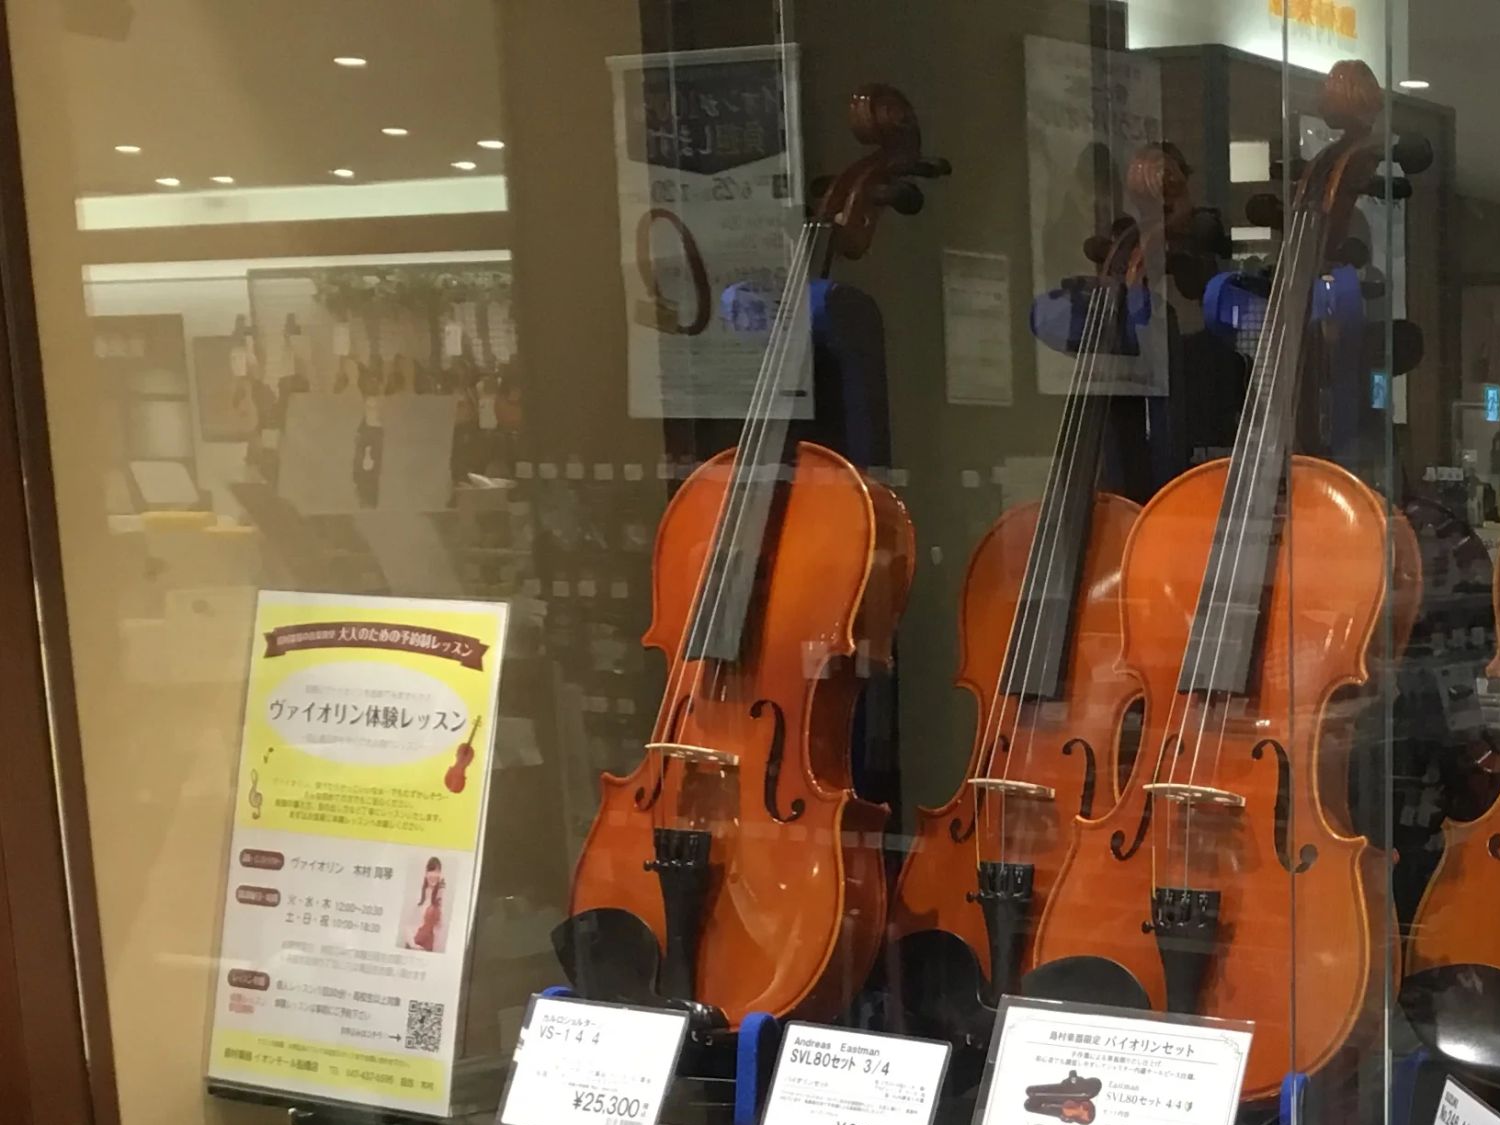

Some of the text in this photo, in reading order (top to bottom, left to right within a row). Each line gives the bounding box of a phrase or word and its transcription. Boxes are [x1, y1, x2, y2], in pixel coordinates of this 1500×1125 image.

[269, 698, 466, 732] ヴァイオリン体験レッスン
[290, 857, 344, 874] ヴァイオリン
[794, 1036, 880, 1057] Andreas Eastman
[1105, 1036, 1195, 1058] バイオリンセット
[790, 1048, 890, 1076] SVL80セット 3/4
[572, 1090, 641, 1118] ¥25,300
